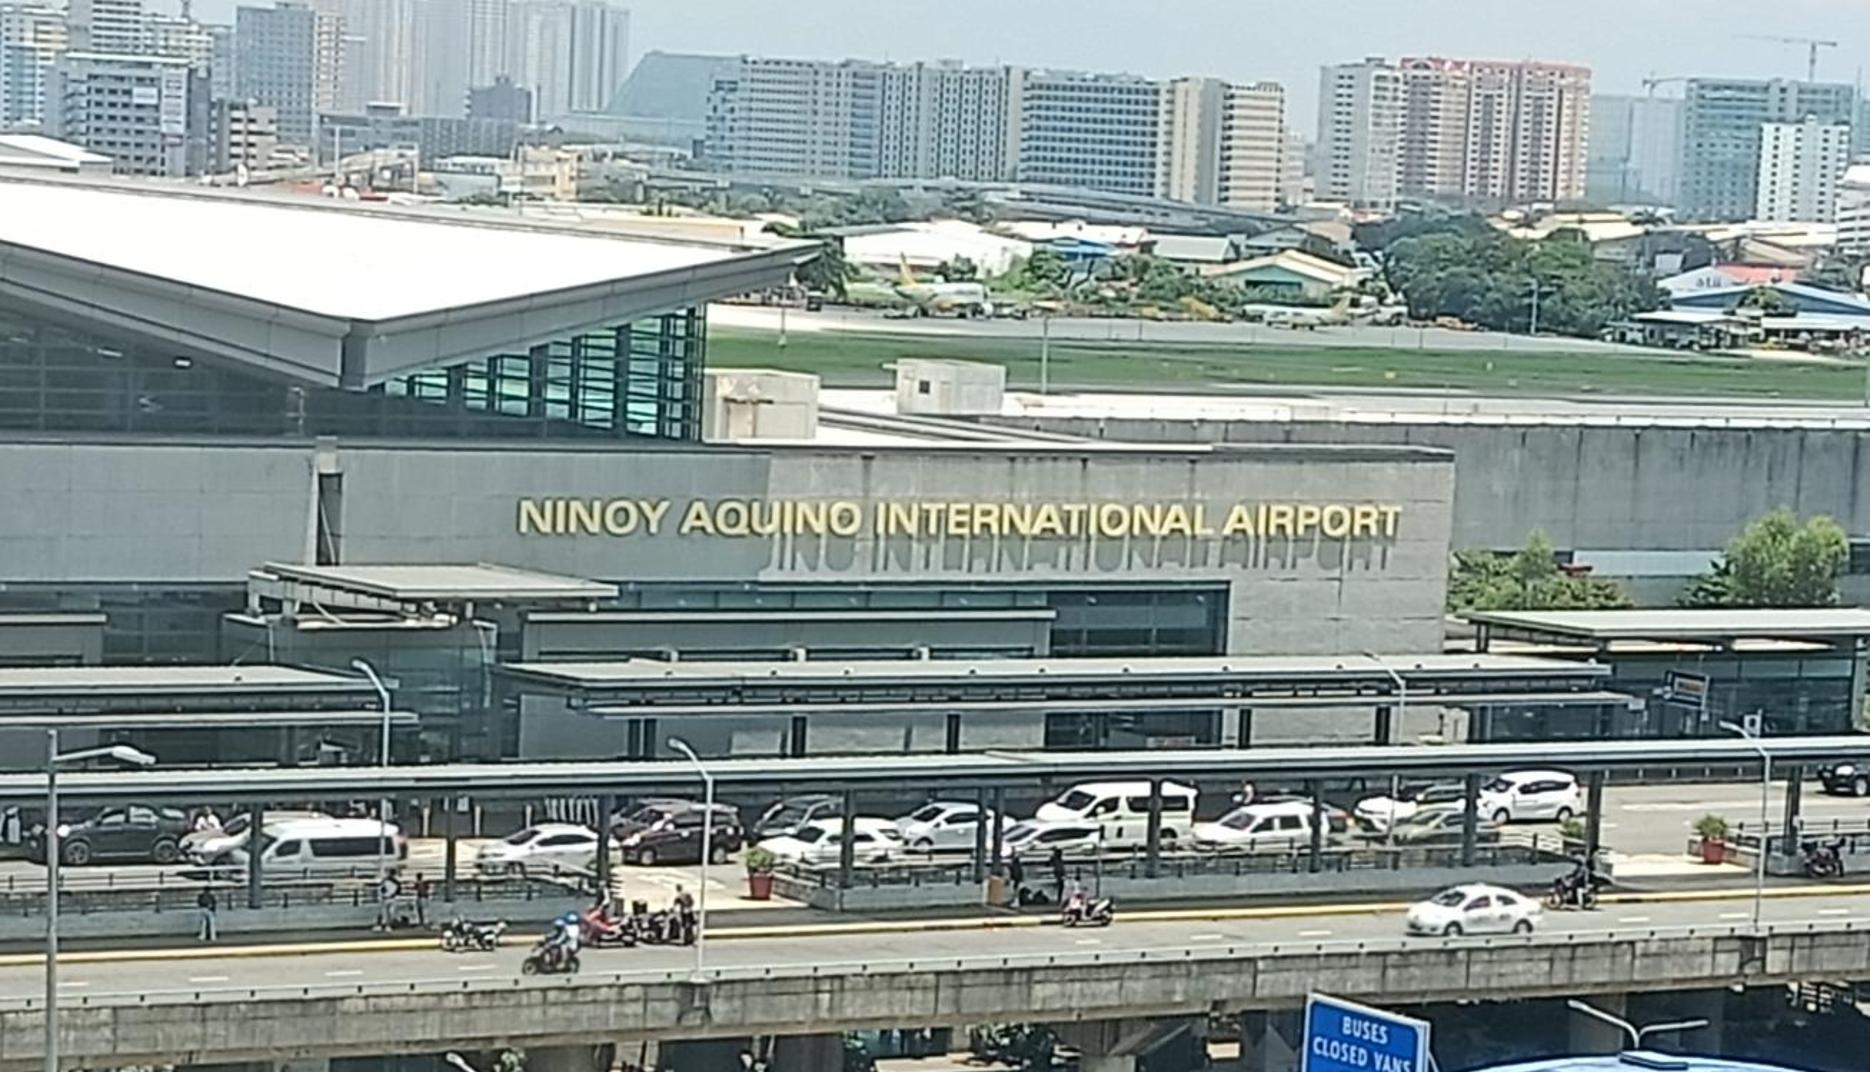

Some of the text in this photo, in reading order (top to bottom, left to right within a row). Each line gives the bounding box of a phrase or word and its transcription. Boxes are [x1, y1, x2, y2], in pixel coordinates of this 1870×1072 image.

[517, 500, 1402, 538] NINOY AQUINO INTERNATIONAL AIRPORT
[1342, 1016, 1388, 1045] BUSES
[1313, 1036, 1368, 1067] CLOSED
